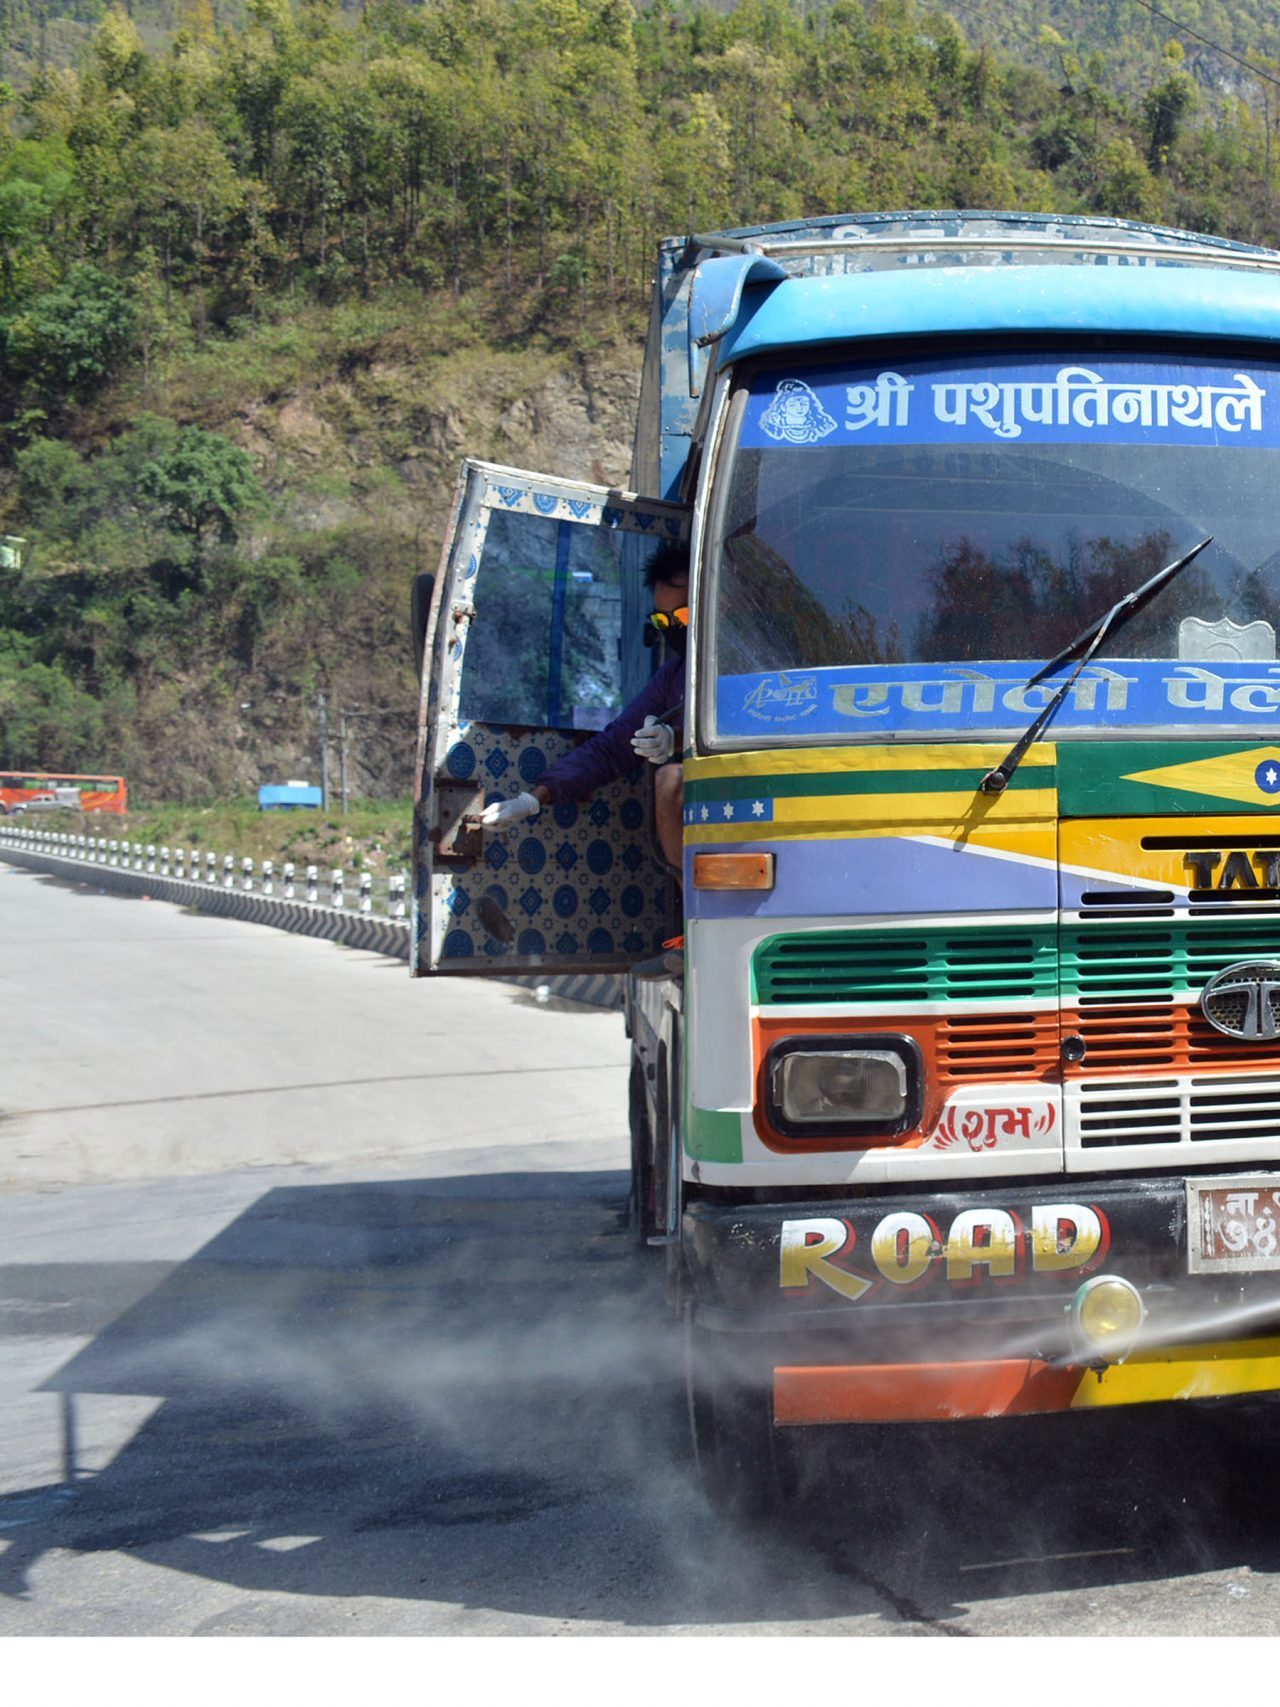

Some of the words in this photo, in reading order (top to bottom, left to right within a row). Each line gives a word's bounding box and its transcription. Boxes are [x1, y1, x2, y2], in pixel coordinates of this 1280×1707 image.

[845, 371, 914, 431] श्री
[932, 367, 1265, 438] पशुपतिनाथले
[829, 667, 1138, 718] एपोलो
[961, 1106, 1033, 1152] शुभ
[780, 1203, 1108, 1300] ROAD
